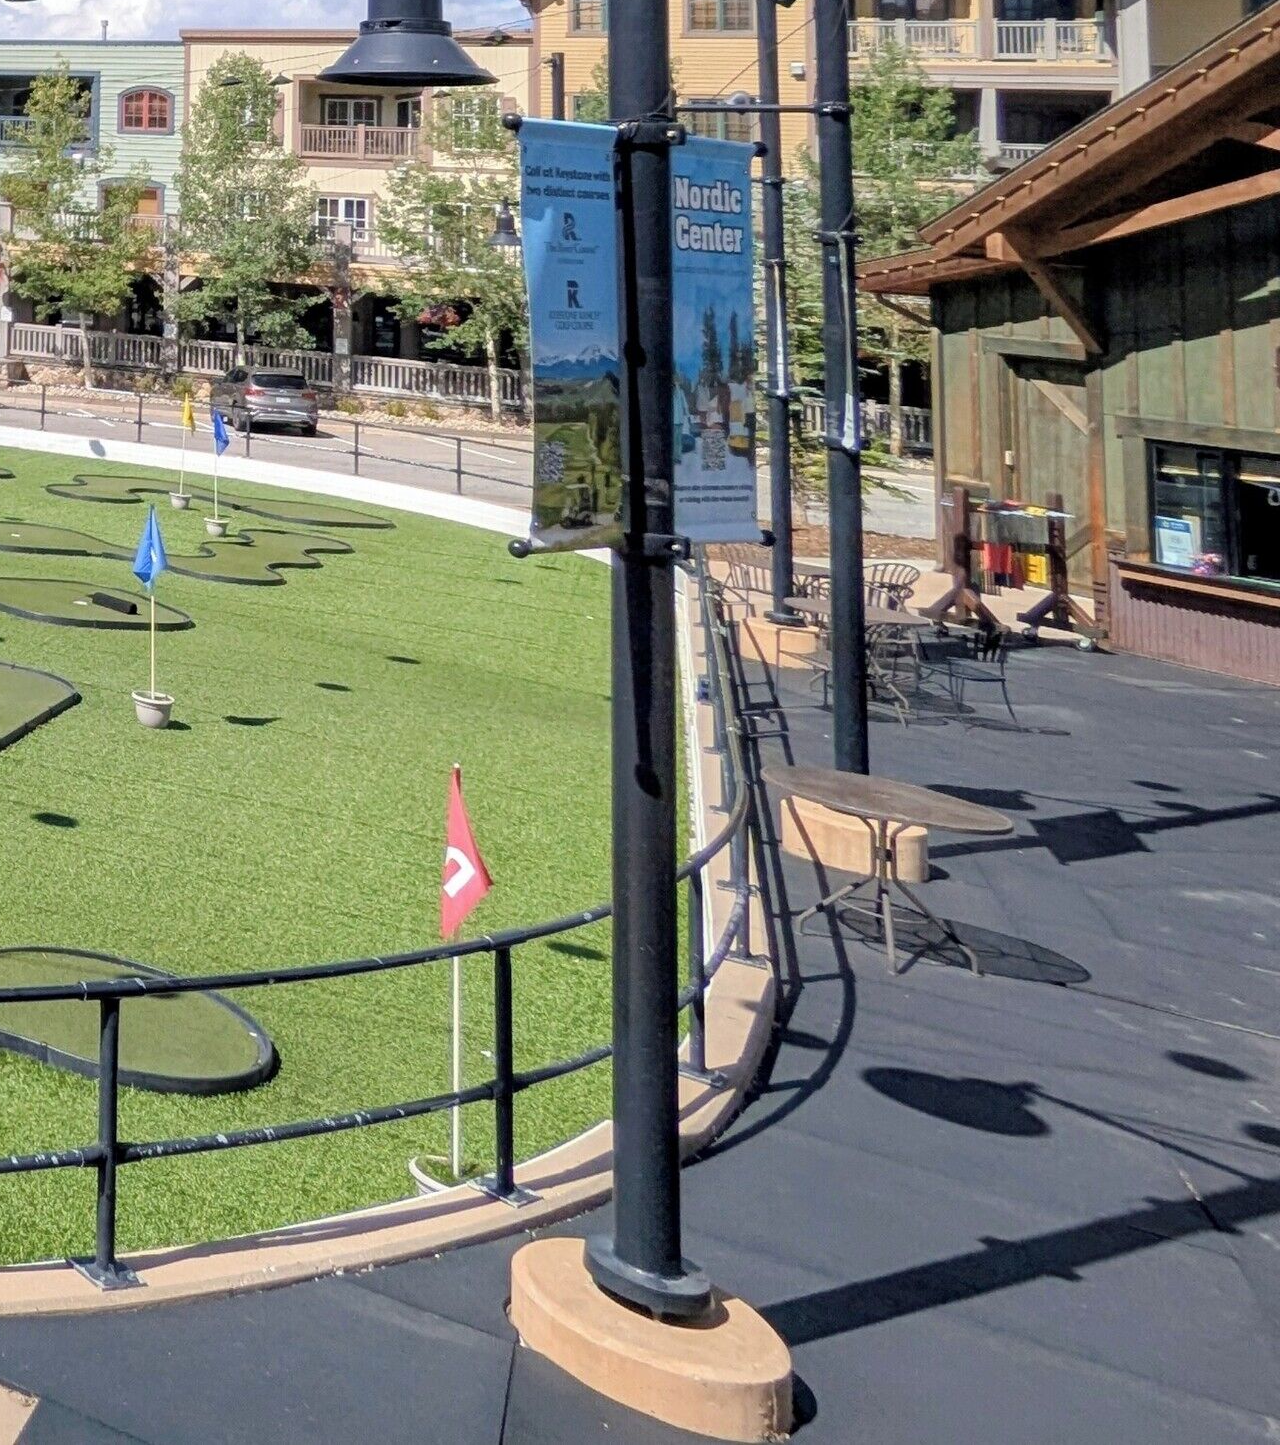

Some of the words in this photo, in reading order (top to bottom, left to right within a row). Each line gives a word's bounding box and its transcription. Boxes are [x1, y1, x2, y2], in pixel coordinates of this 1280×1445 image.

[555, 167, 592, 181] Keystone
[593, 170, 611, 182] with
[576, 189, 610, 200] courses
[674, 175, 742, 214] Nordic
[675, 214, 744, 255] Center
